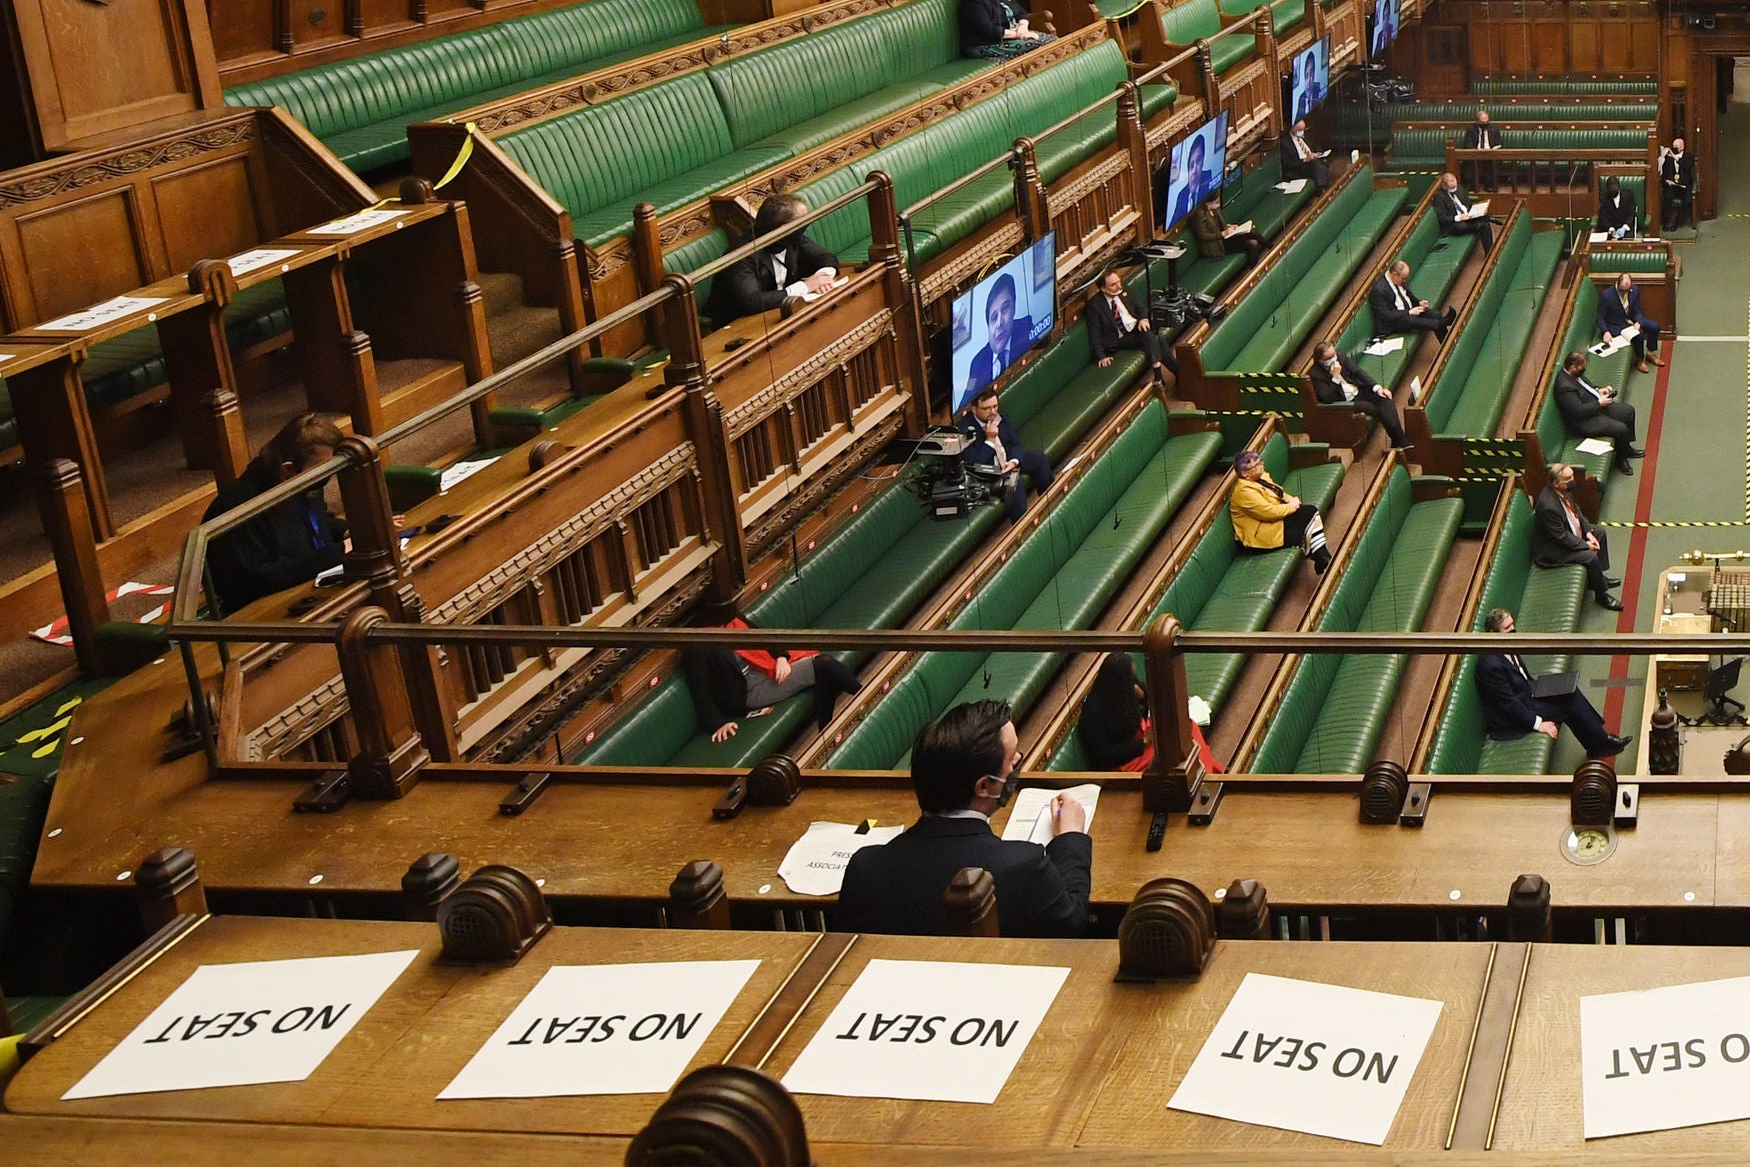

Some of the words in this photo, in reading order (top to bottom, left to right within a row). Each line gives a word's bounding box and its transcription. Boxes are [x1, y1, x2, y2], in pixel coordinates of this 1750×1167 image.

[806, 861, 848, 871] ASSOCIAT
[831, 850, 852, 859] PRES
[144, 1010, 271, 1043] SEAT
[272, 1004, 351, 1033] NO
[508, 1016, 626, 1045] SEAT
[629, 1013, 702, 1041] NO
[836, 1013, 946, 1043] SEAT
[951, 1018, 1019, 1047] NO
[1221, 1031, 1326, 1070] SEAT
[1605, 1039, 1705, 1079] SEAT
[1333, 1049, 1398, 1083] NO
